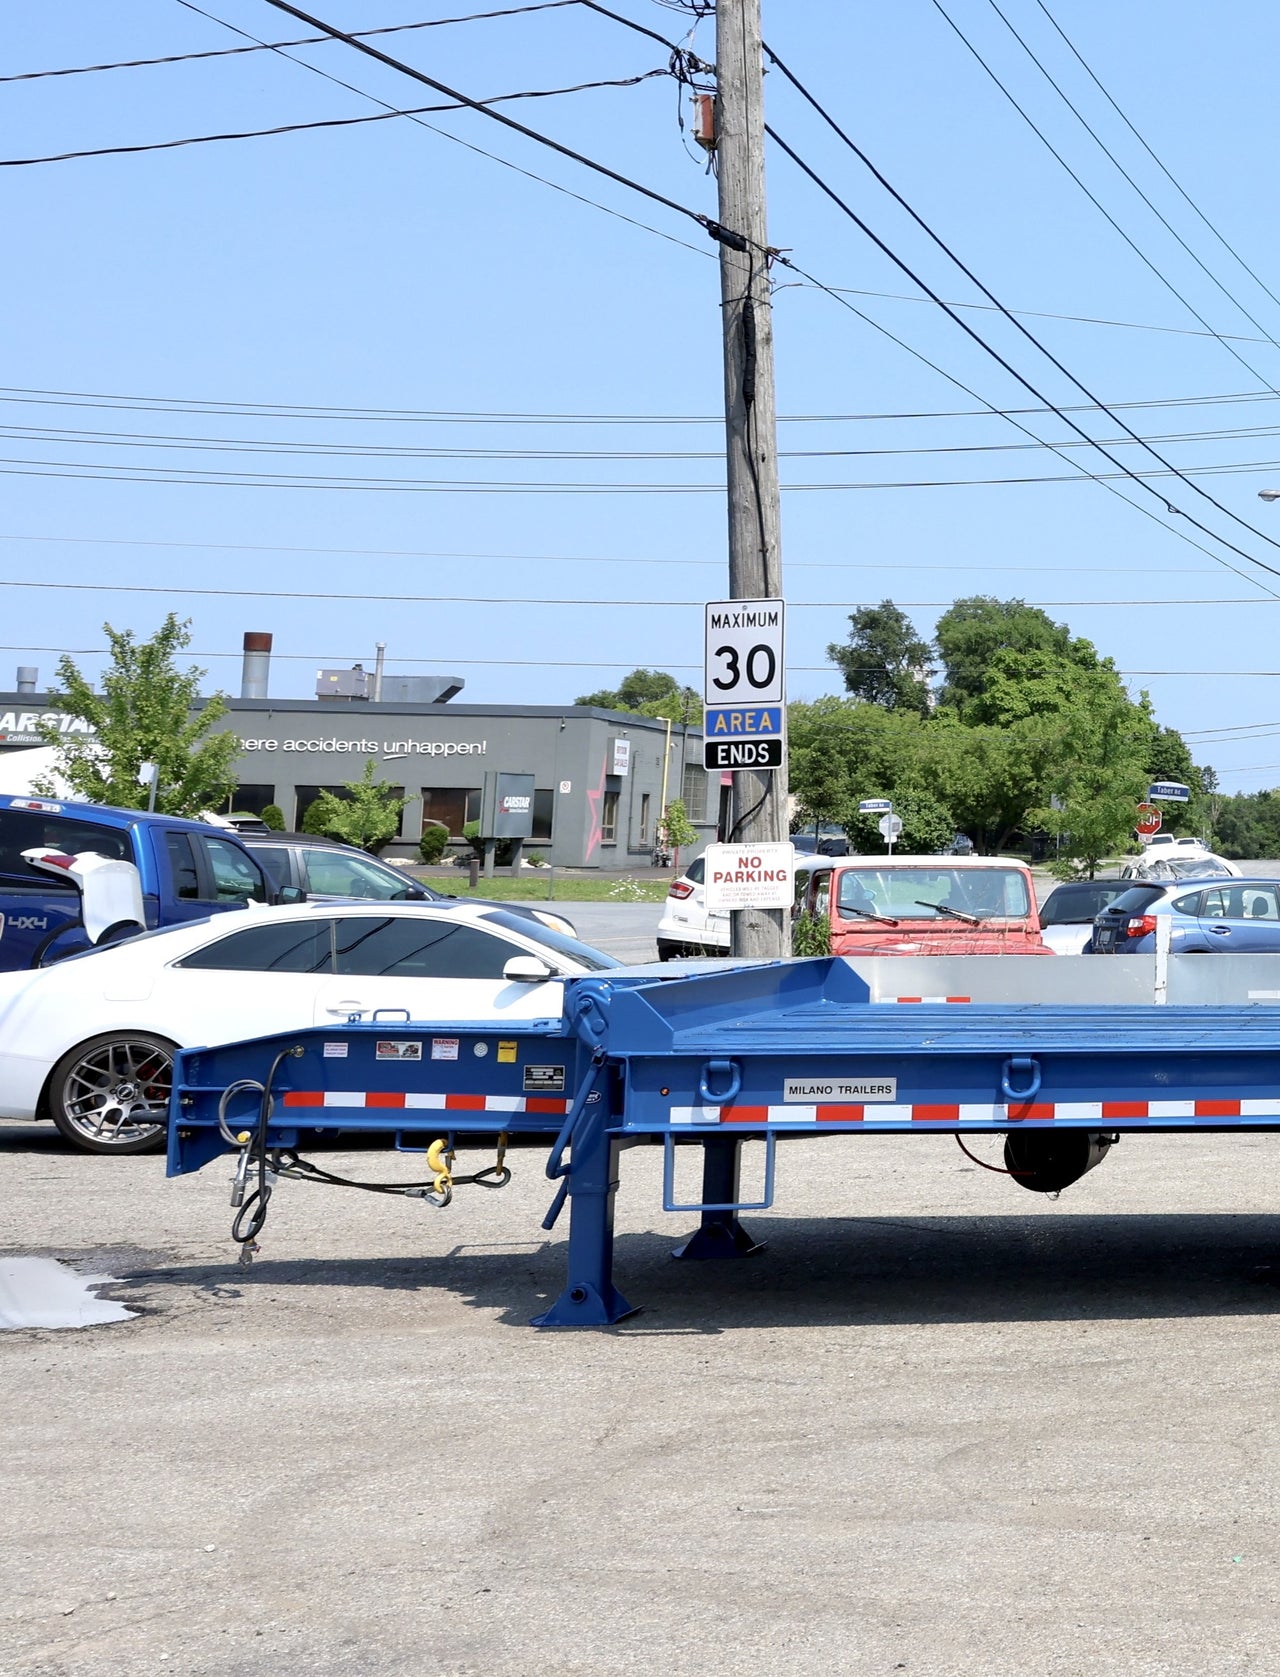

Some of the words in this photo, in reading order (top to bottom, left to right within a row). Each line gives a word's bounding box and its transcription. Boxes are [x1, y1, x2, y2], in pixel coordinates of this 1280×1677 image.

[711, 612, 778, 629] MAXIMUM
[712, 644, 776, 691] 30
[0, 712, 98, 732] ARSTA
[714, 712, 773, 733] AREA
[7, 734, 42, 742] Collision
[283, 737, 378, 753] accidents
[383, 739, 487, 757] unhappen!
[717, 743, 769, 765] ENDS
[503, 797, 531, 808] CARSTAR
[738, 856, 762, 869] NO
[713, 869, 787, 883] PARKING
[8, 916, 47, 929] 4X4
[789, 1085, 833, 1095] MILANO
[838, 1085, 892, 1094] TRAILERS
